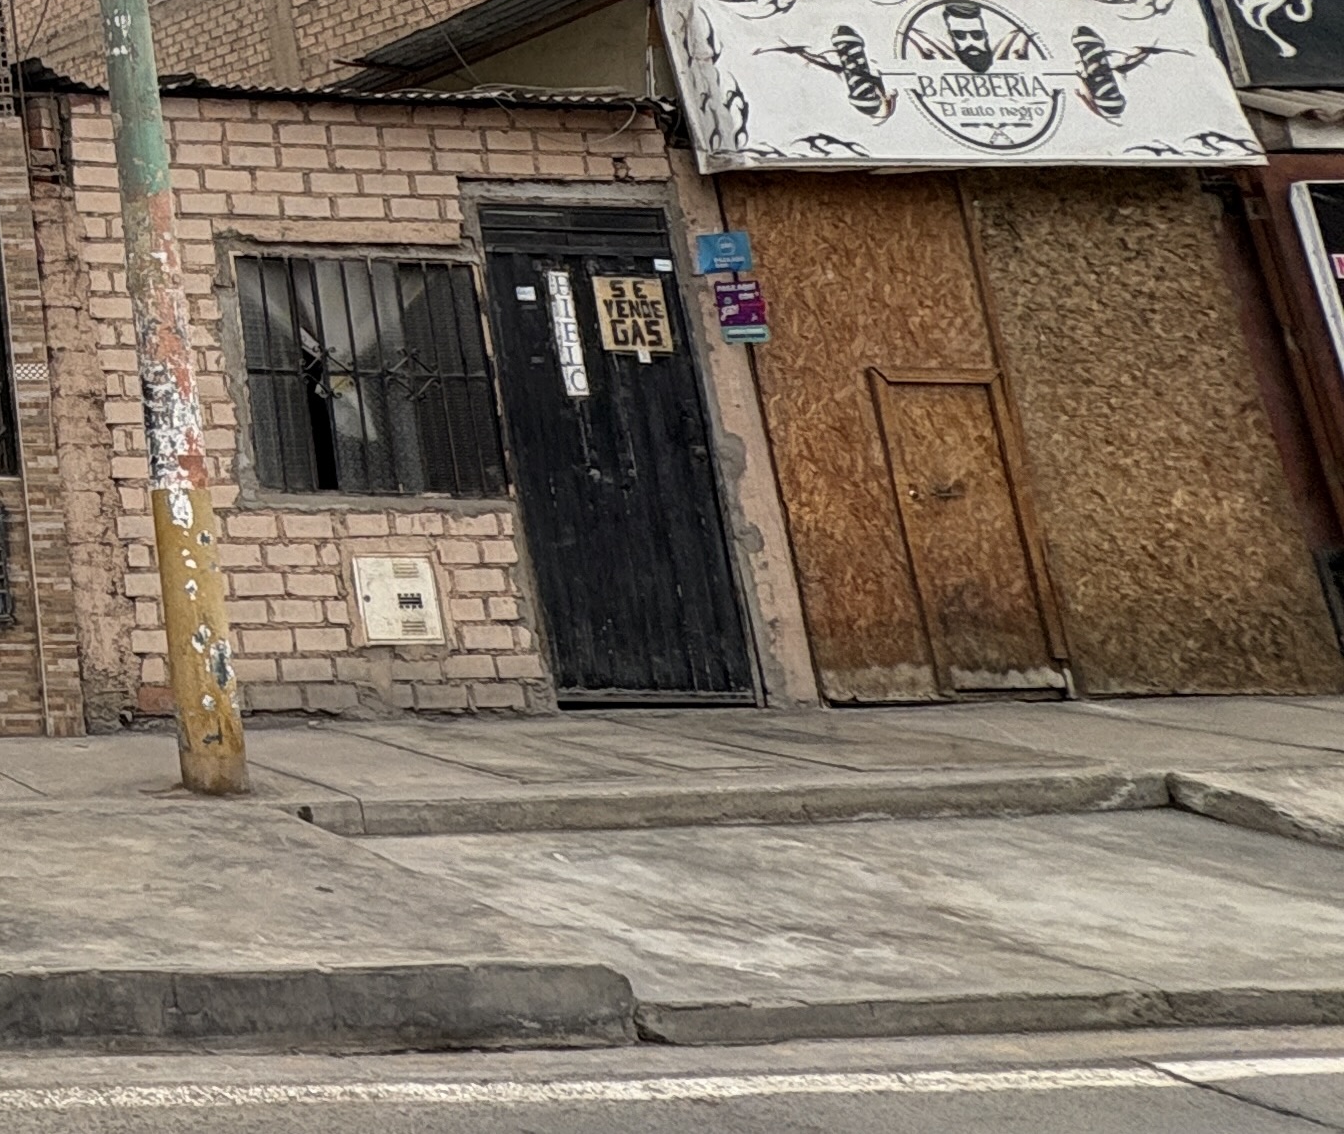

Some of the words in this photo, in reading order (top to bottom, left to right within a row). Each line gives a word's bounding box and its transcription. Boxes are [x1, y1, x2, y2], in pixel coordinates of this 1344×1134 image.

[941, 104, 957, 117] El
[961, 105, 995, 117] auto
[999, 105, 1045, 122] negro
[610, 279, 648, 300] SE
[602, 299, 665, 319] VENDE
[609, 319, 663, 347] GAS
